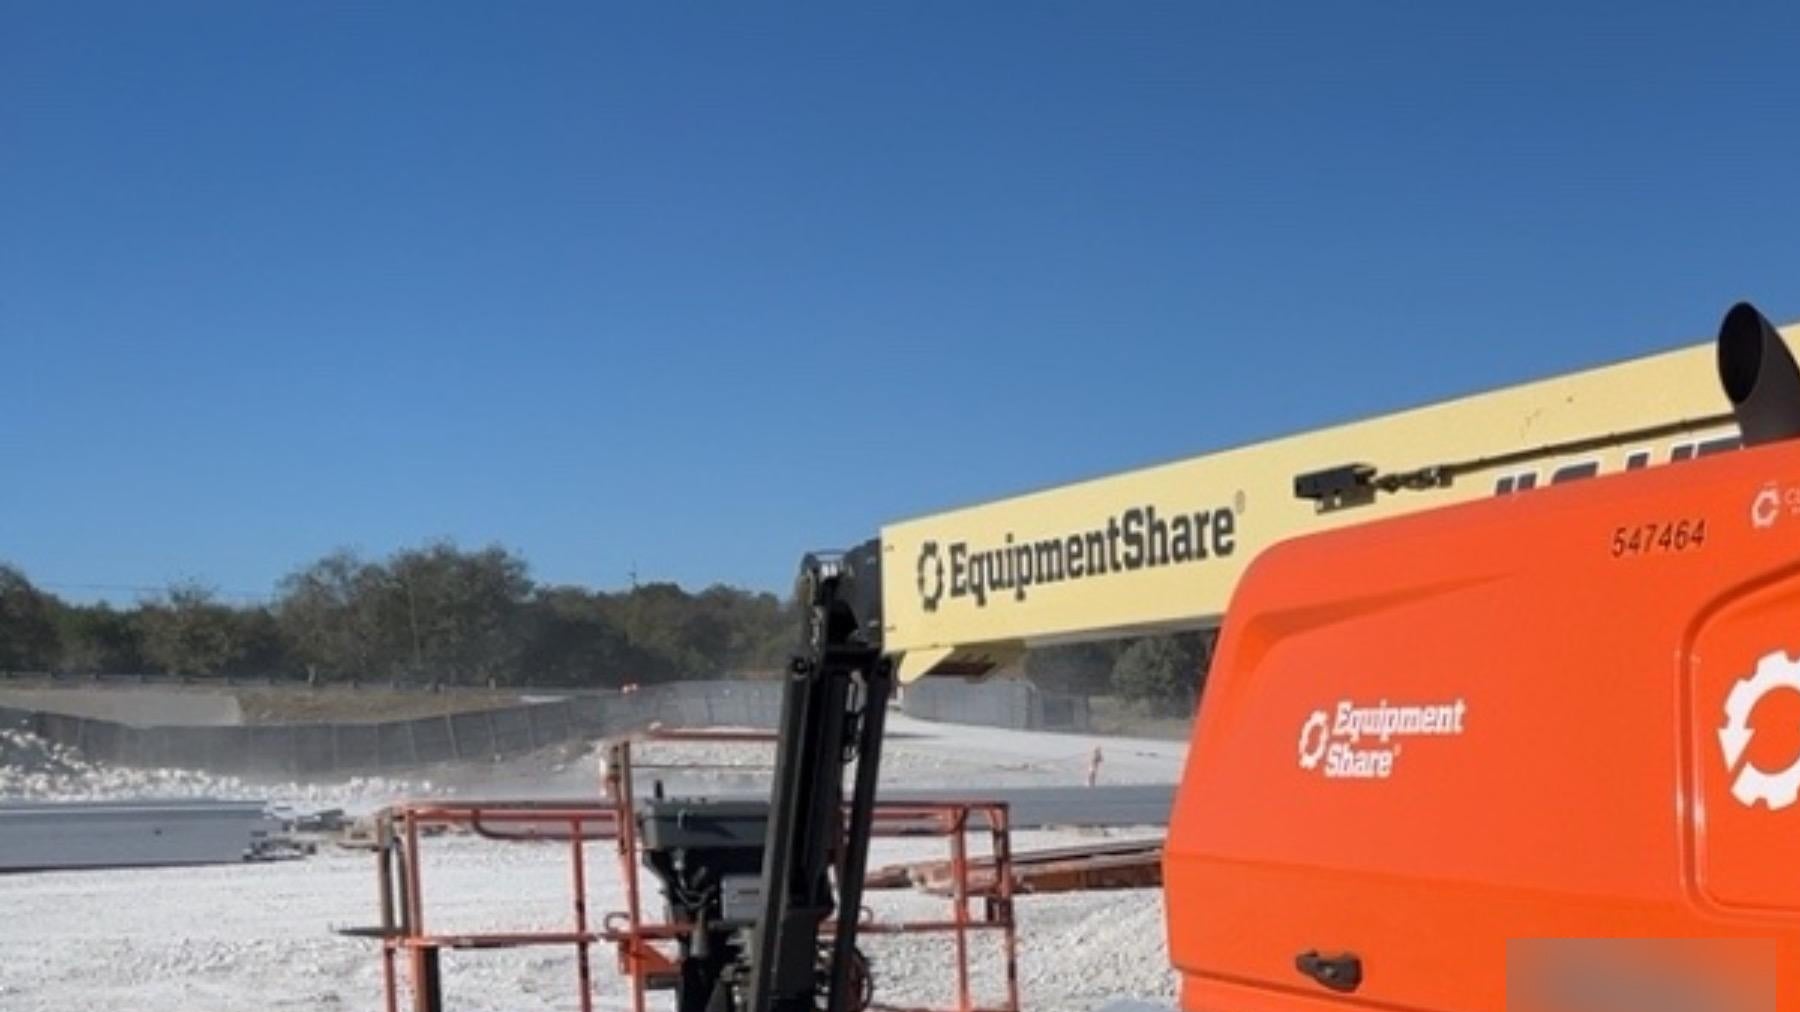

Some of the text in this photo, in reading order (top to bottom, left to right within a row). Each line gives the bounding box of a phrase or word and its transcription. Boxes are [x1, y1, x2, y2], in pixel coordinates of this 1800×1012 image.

[948, 505, 1236, 607] EquipmentShare
[1611, 518, 1705, 559] 547464
[1332, 698, 1466, 743] Equipment
[1324, 742, 1394, 778] Share
